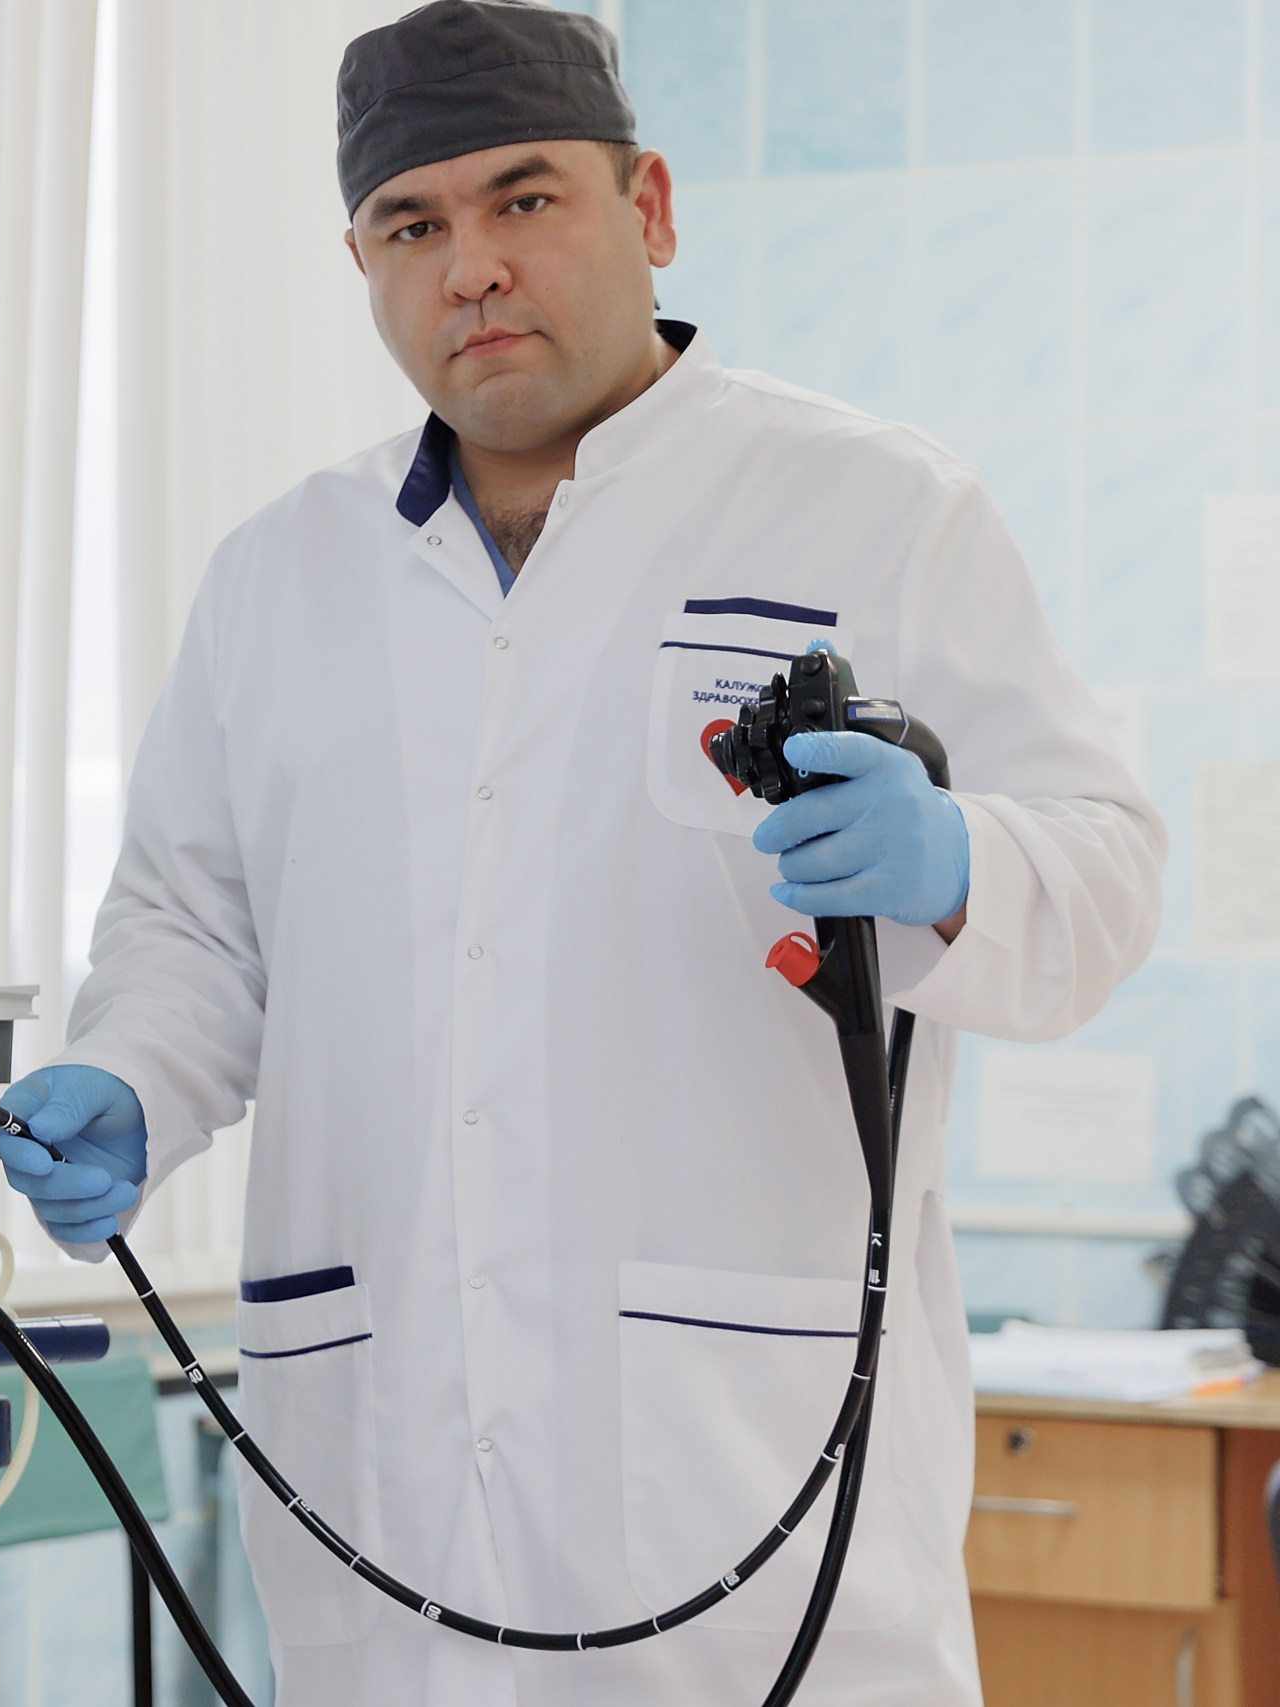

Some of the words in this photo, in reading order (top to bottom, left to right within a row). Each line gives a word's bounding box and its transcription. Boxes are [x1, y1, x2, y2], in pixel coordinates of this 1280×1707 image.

[6, 1122, 21, 1135] 20
[189, 1368, 204, 1384] 40
[426, 1604, 442, 1620] 60
